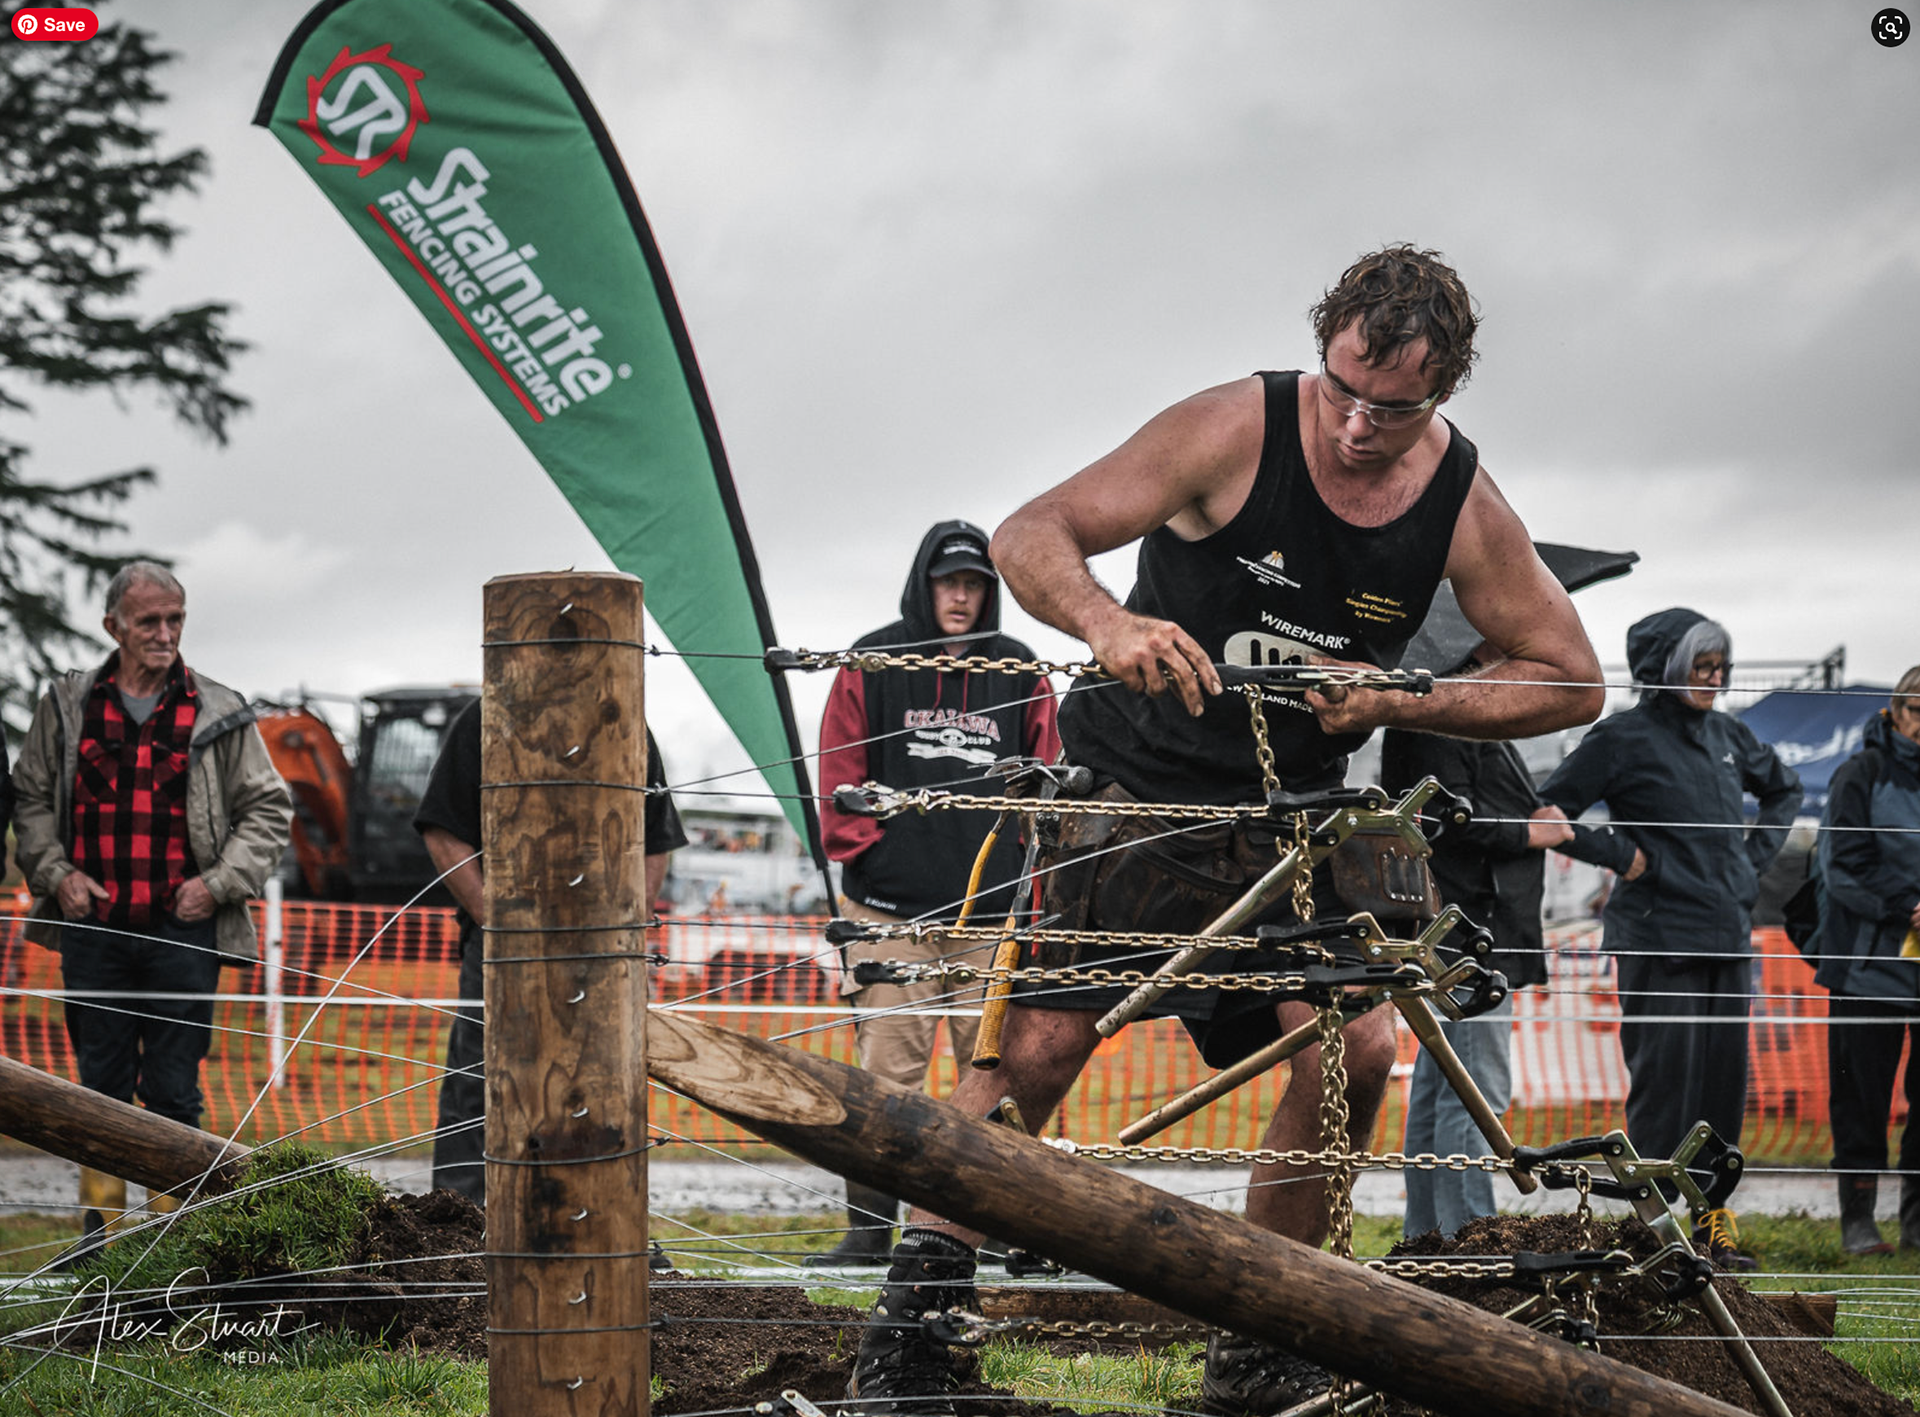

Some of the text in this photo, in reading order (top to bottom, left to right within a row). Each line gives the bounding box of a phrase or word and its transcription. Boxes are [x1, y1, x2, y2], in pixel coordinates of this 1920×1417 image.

[378, 189, 482, 306] FENCING
[470, 303, 570, 417] SYSTEMS
[1288, 699, 1314, 714] MADE
[966, 735, 993, 746] CLUB
